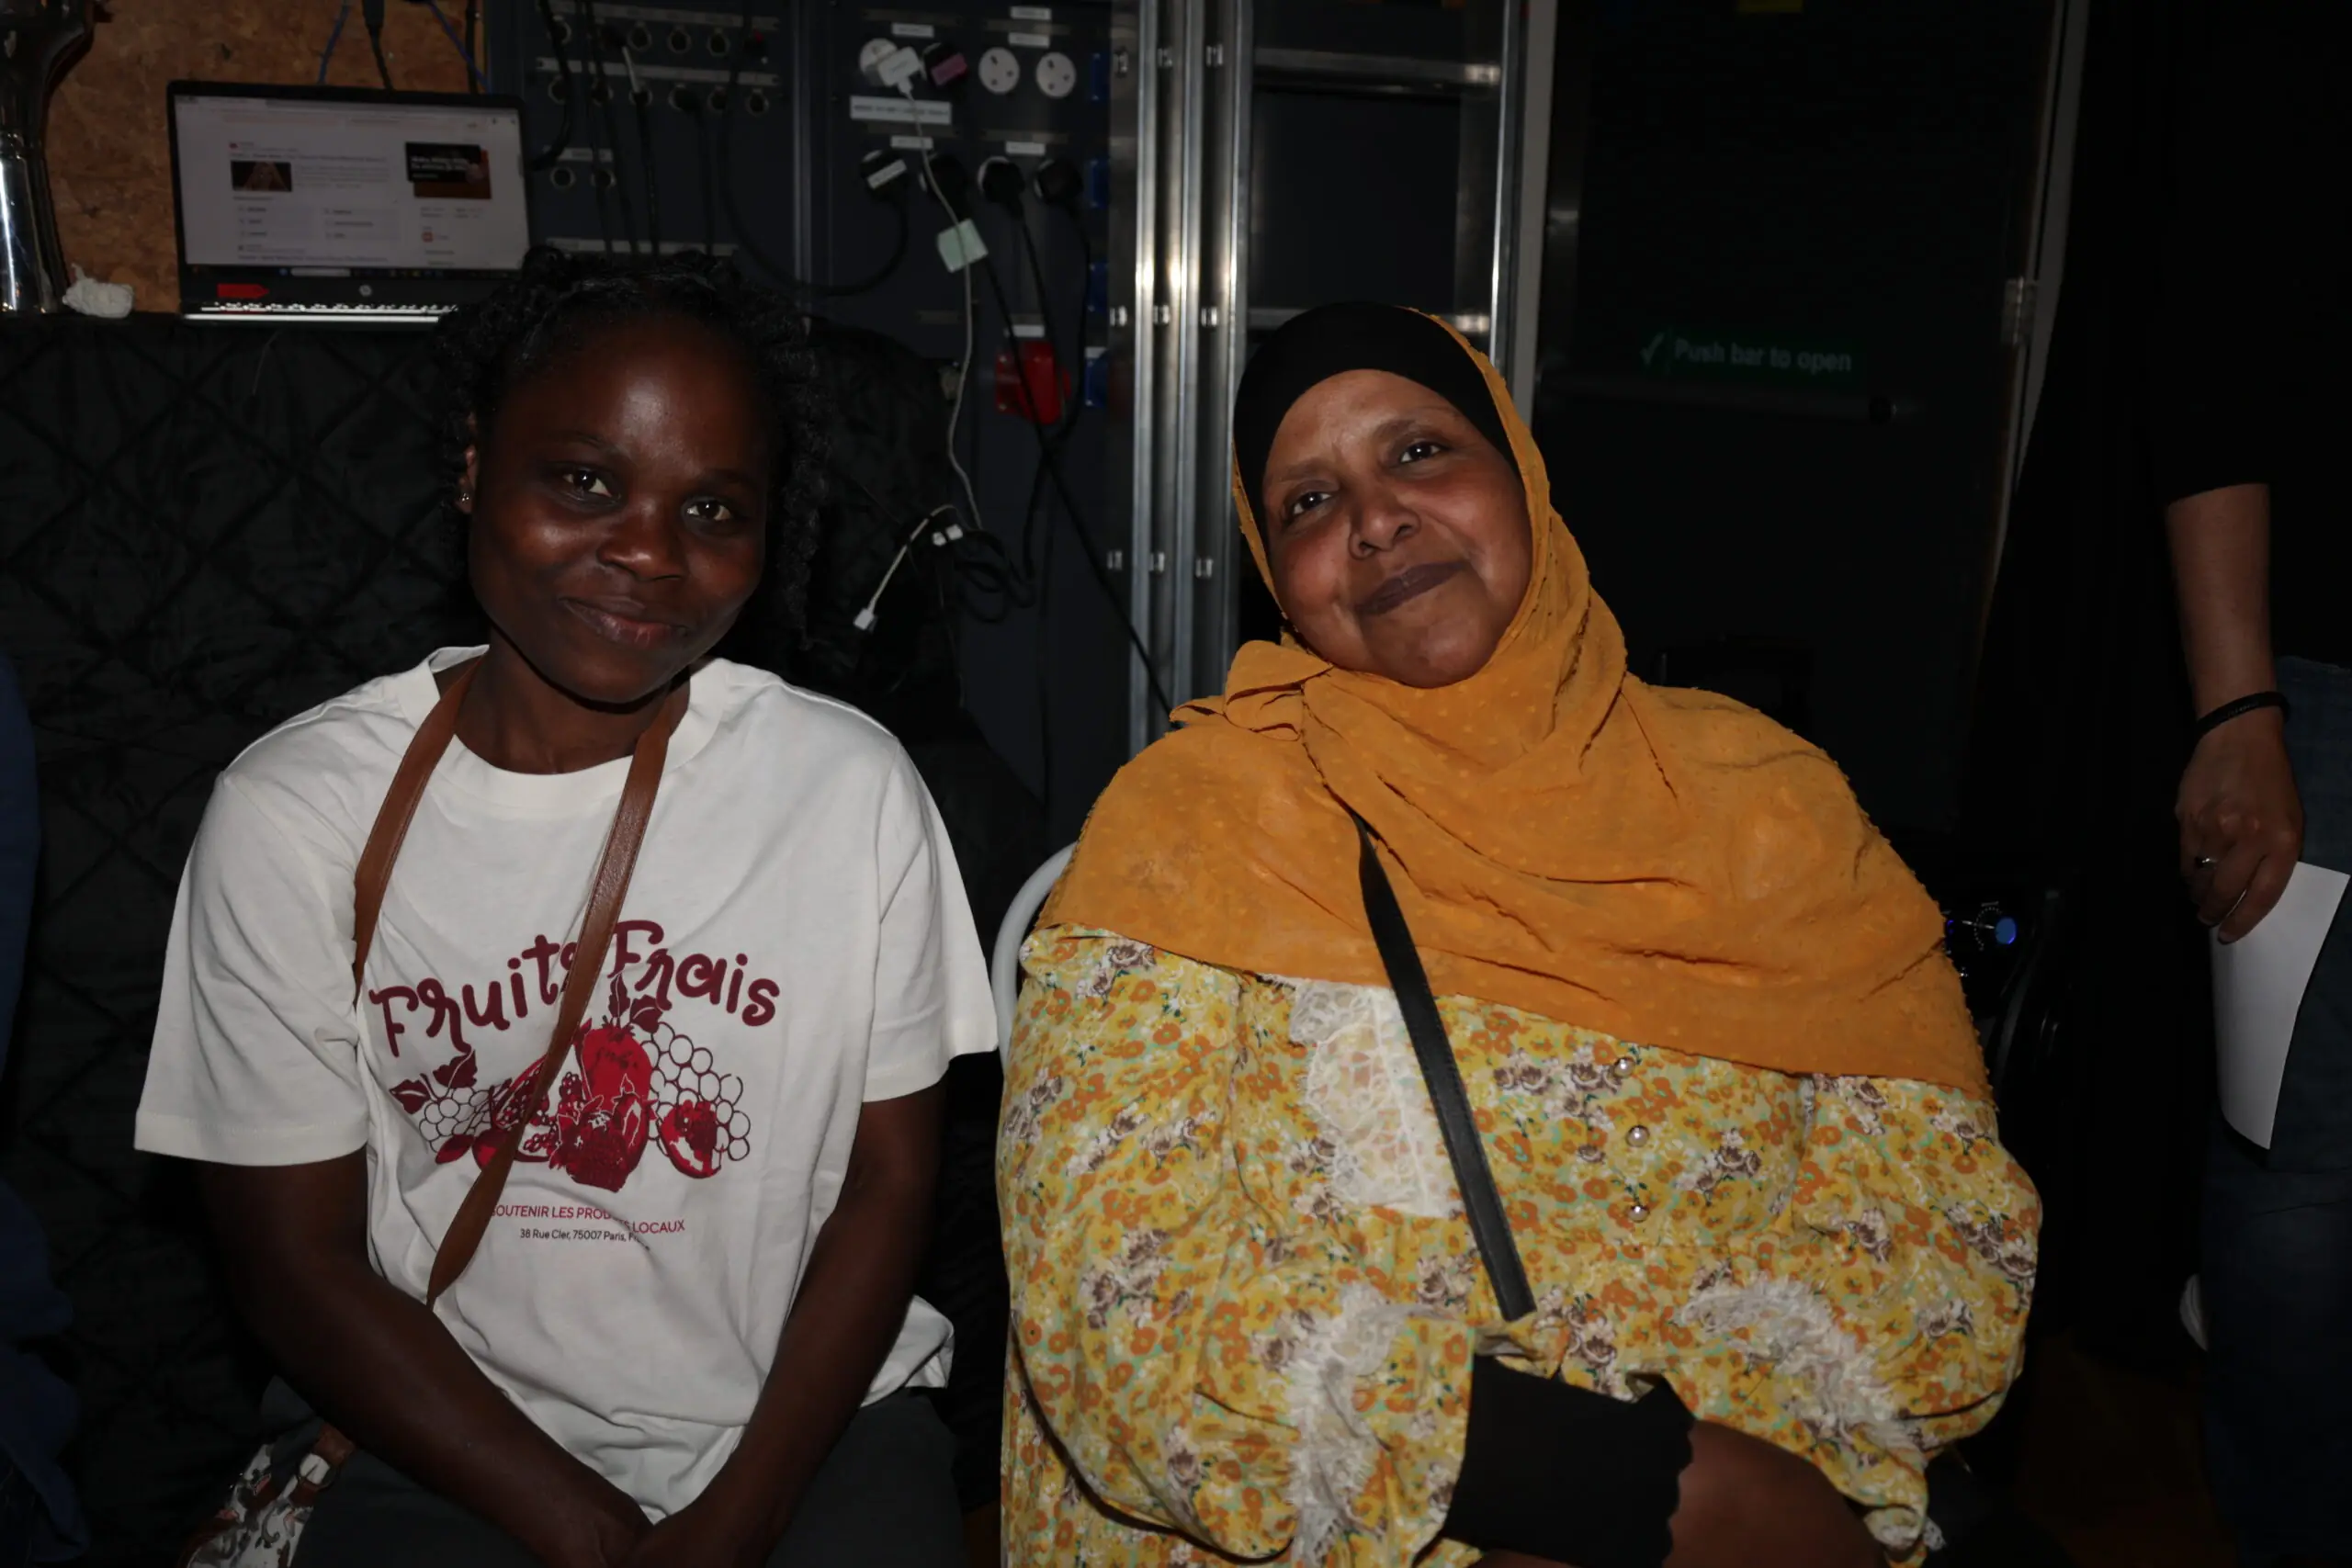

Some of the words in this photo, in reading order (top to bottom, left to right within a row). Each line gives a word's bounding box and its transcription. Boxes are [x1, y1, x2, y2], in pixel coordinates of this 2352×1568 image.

[1675, 337, 1725, 363] Push
[1730, 342, 1764, 366] bar
[1770, 345, 1791, 369] to
[1796, 351, 1852, 376] open
[607, 920, 780, 1026] Frais
[520, 1228, 531, 1239] 38
[533, 1229, 550, 1239] Rue
[551, 1229, 571, 1241] Cler,
[572, 1230, 602, 1240] 75007
[604, 1231, 627, 1242] Paris,
[552, 1206, 574, 1219] LES
[632, 1219, 685, 1234] LOCAUX
